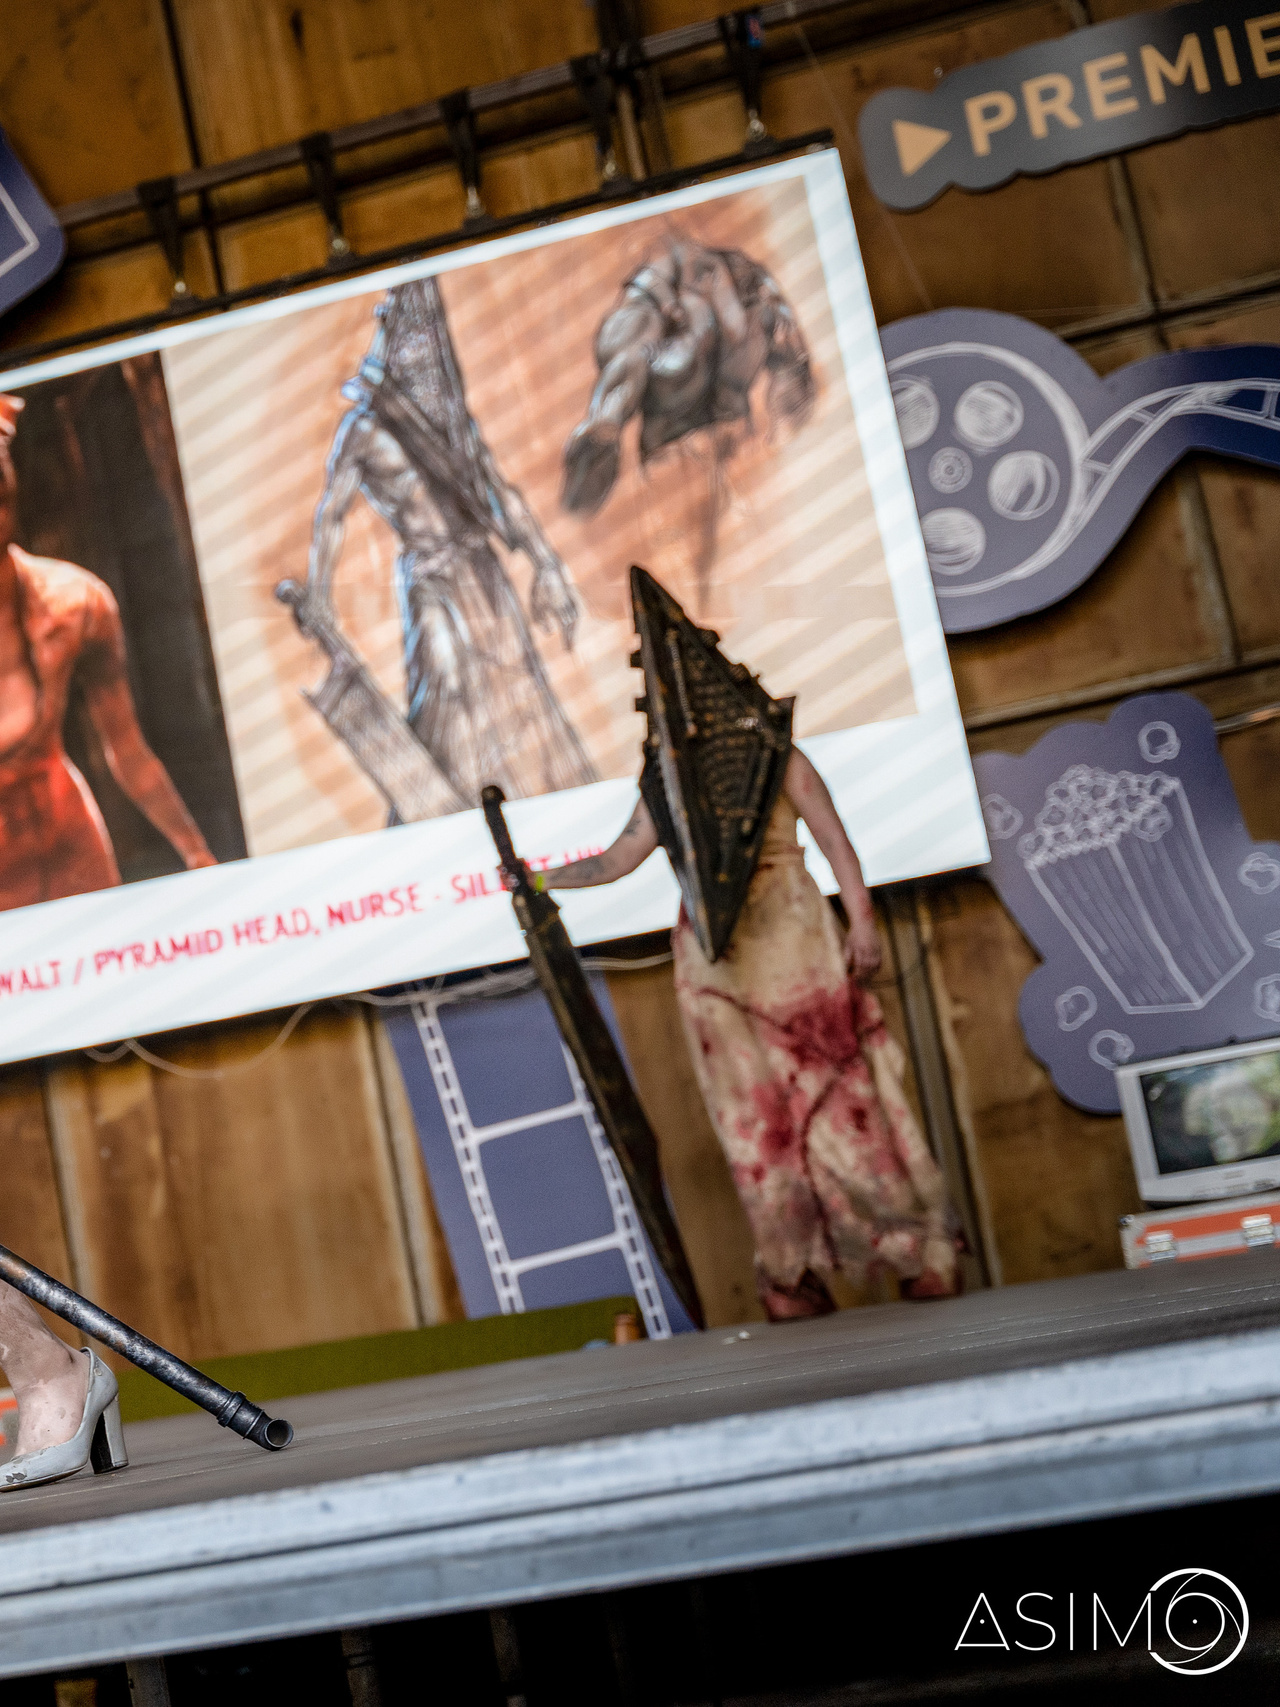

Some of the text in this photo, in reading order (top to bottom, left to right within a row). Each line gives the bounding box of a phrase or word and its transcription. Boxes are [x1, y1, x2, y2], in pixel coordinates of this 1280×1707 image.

[93, 929, 224, 976] PYRAMID
[326, 881, 424, 928] NURSE
[450, 855, 554, 904] SILT
